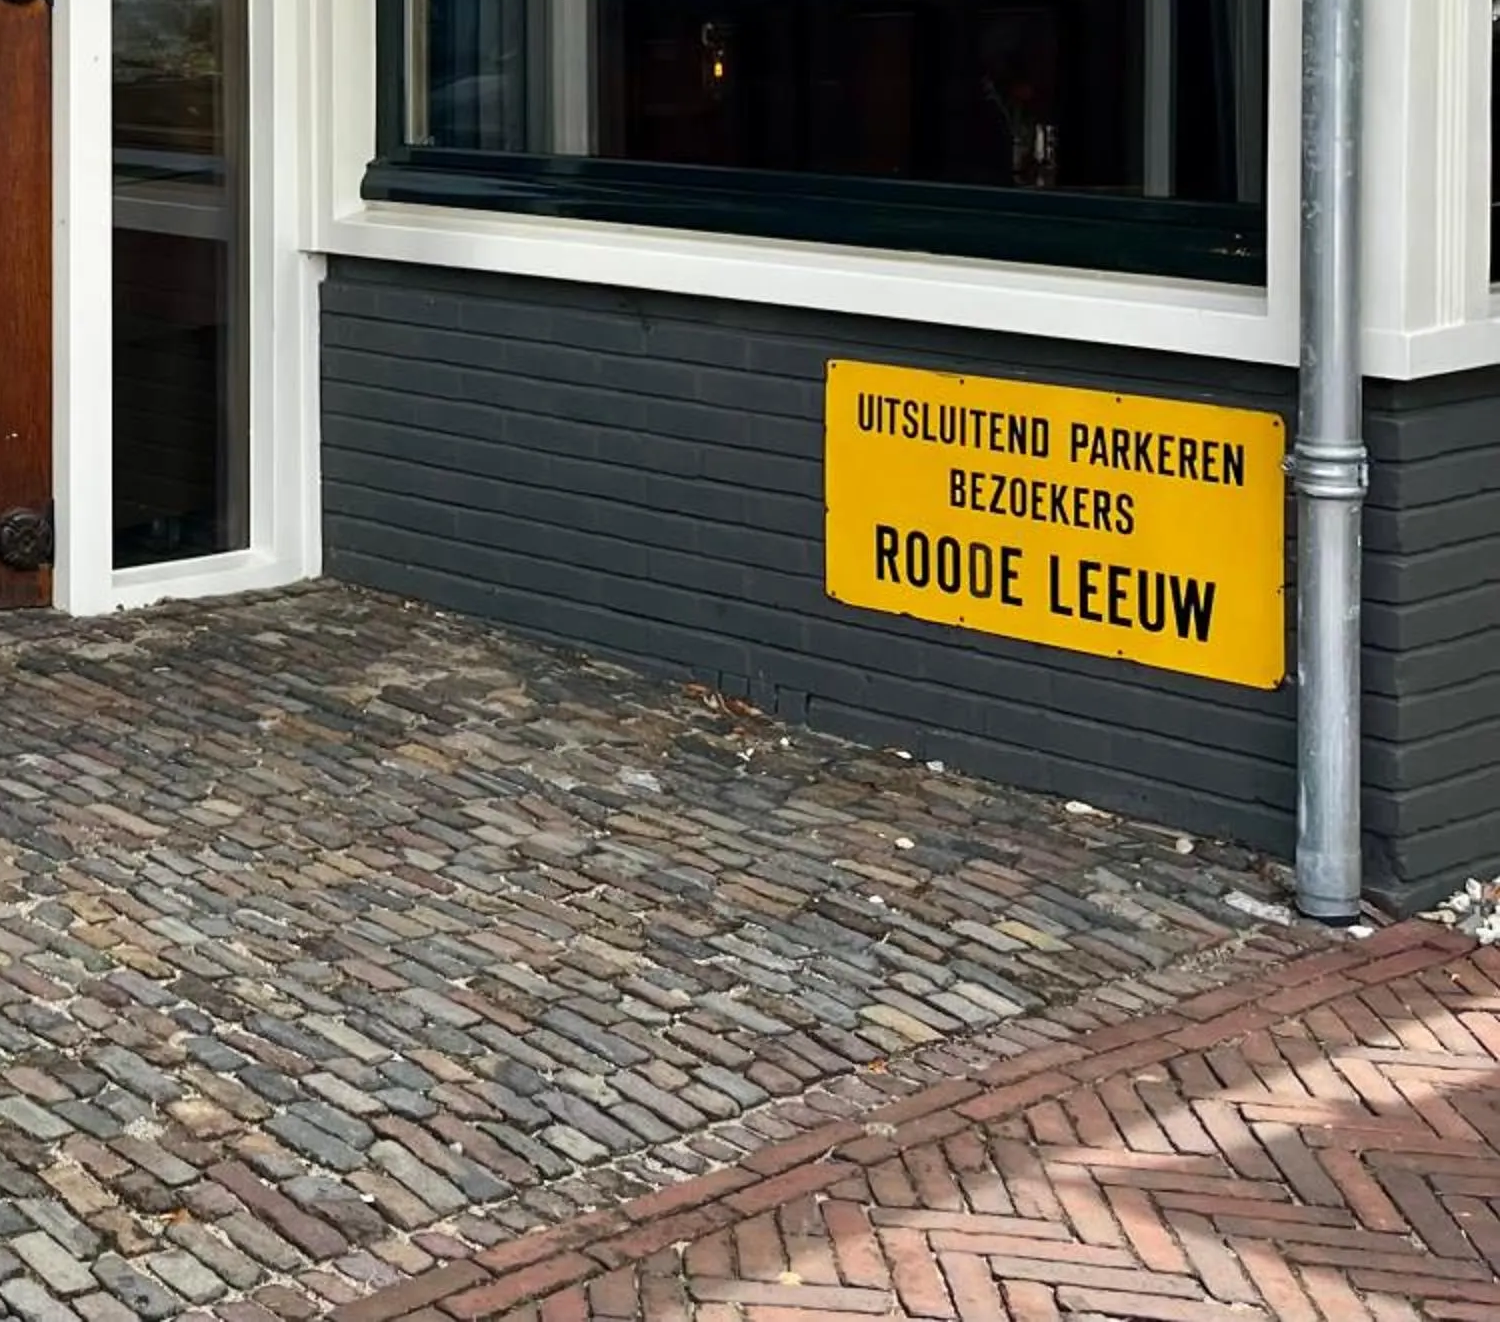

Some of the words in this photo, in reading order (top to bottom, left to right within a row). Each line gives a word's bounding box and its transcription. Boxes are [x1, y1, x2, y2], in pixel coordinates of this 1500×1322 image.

[857, 392, 1049, 459] UITSLUITEND
[1070, 421, 1245, 487] PARKEREN
[949, 468, 1134, 535] BEZOEKERS
[875, 524, 1023, 607] ROODE
[1049, 554, 1216, 643] LEEUW
